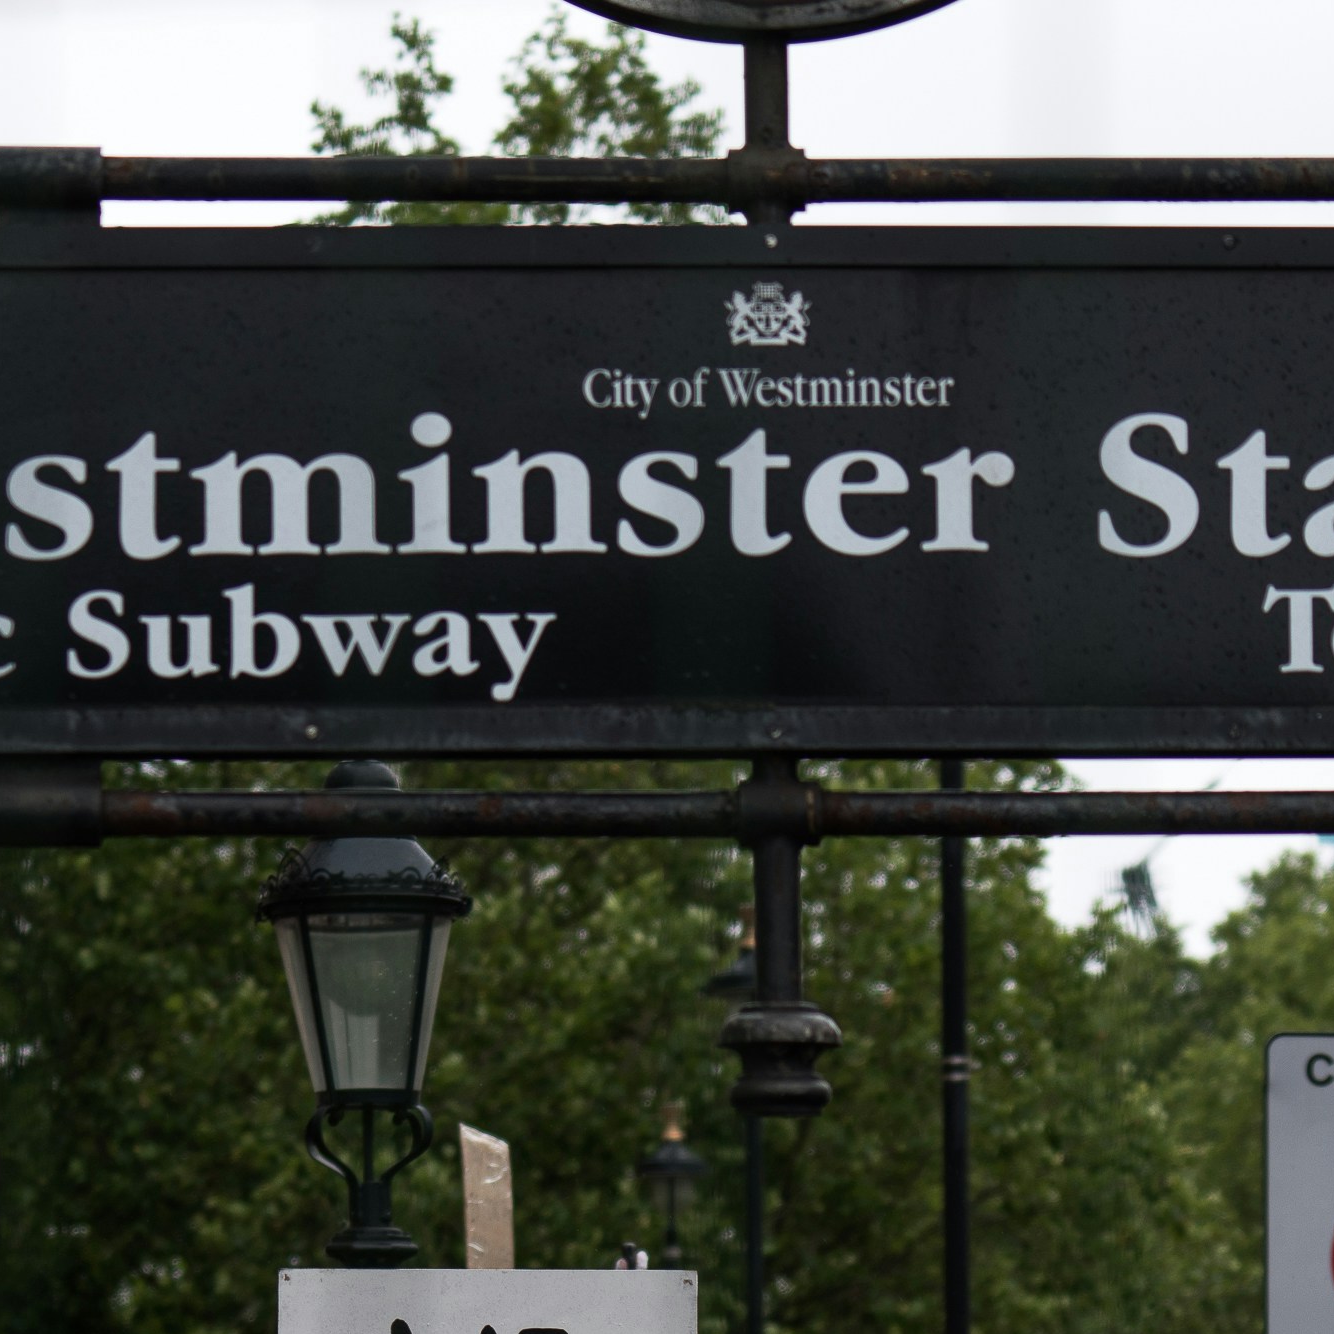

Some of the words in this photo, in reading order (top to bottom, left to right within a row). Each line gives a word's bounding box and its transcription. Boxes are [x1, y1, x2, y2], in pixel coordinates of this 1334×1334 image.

[584, 369, 657, 418] City
[669, 368, 710, 407] of
[718, 368, 955, 408] Westminster
[67, 584, 555, 701] Subway
